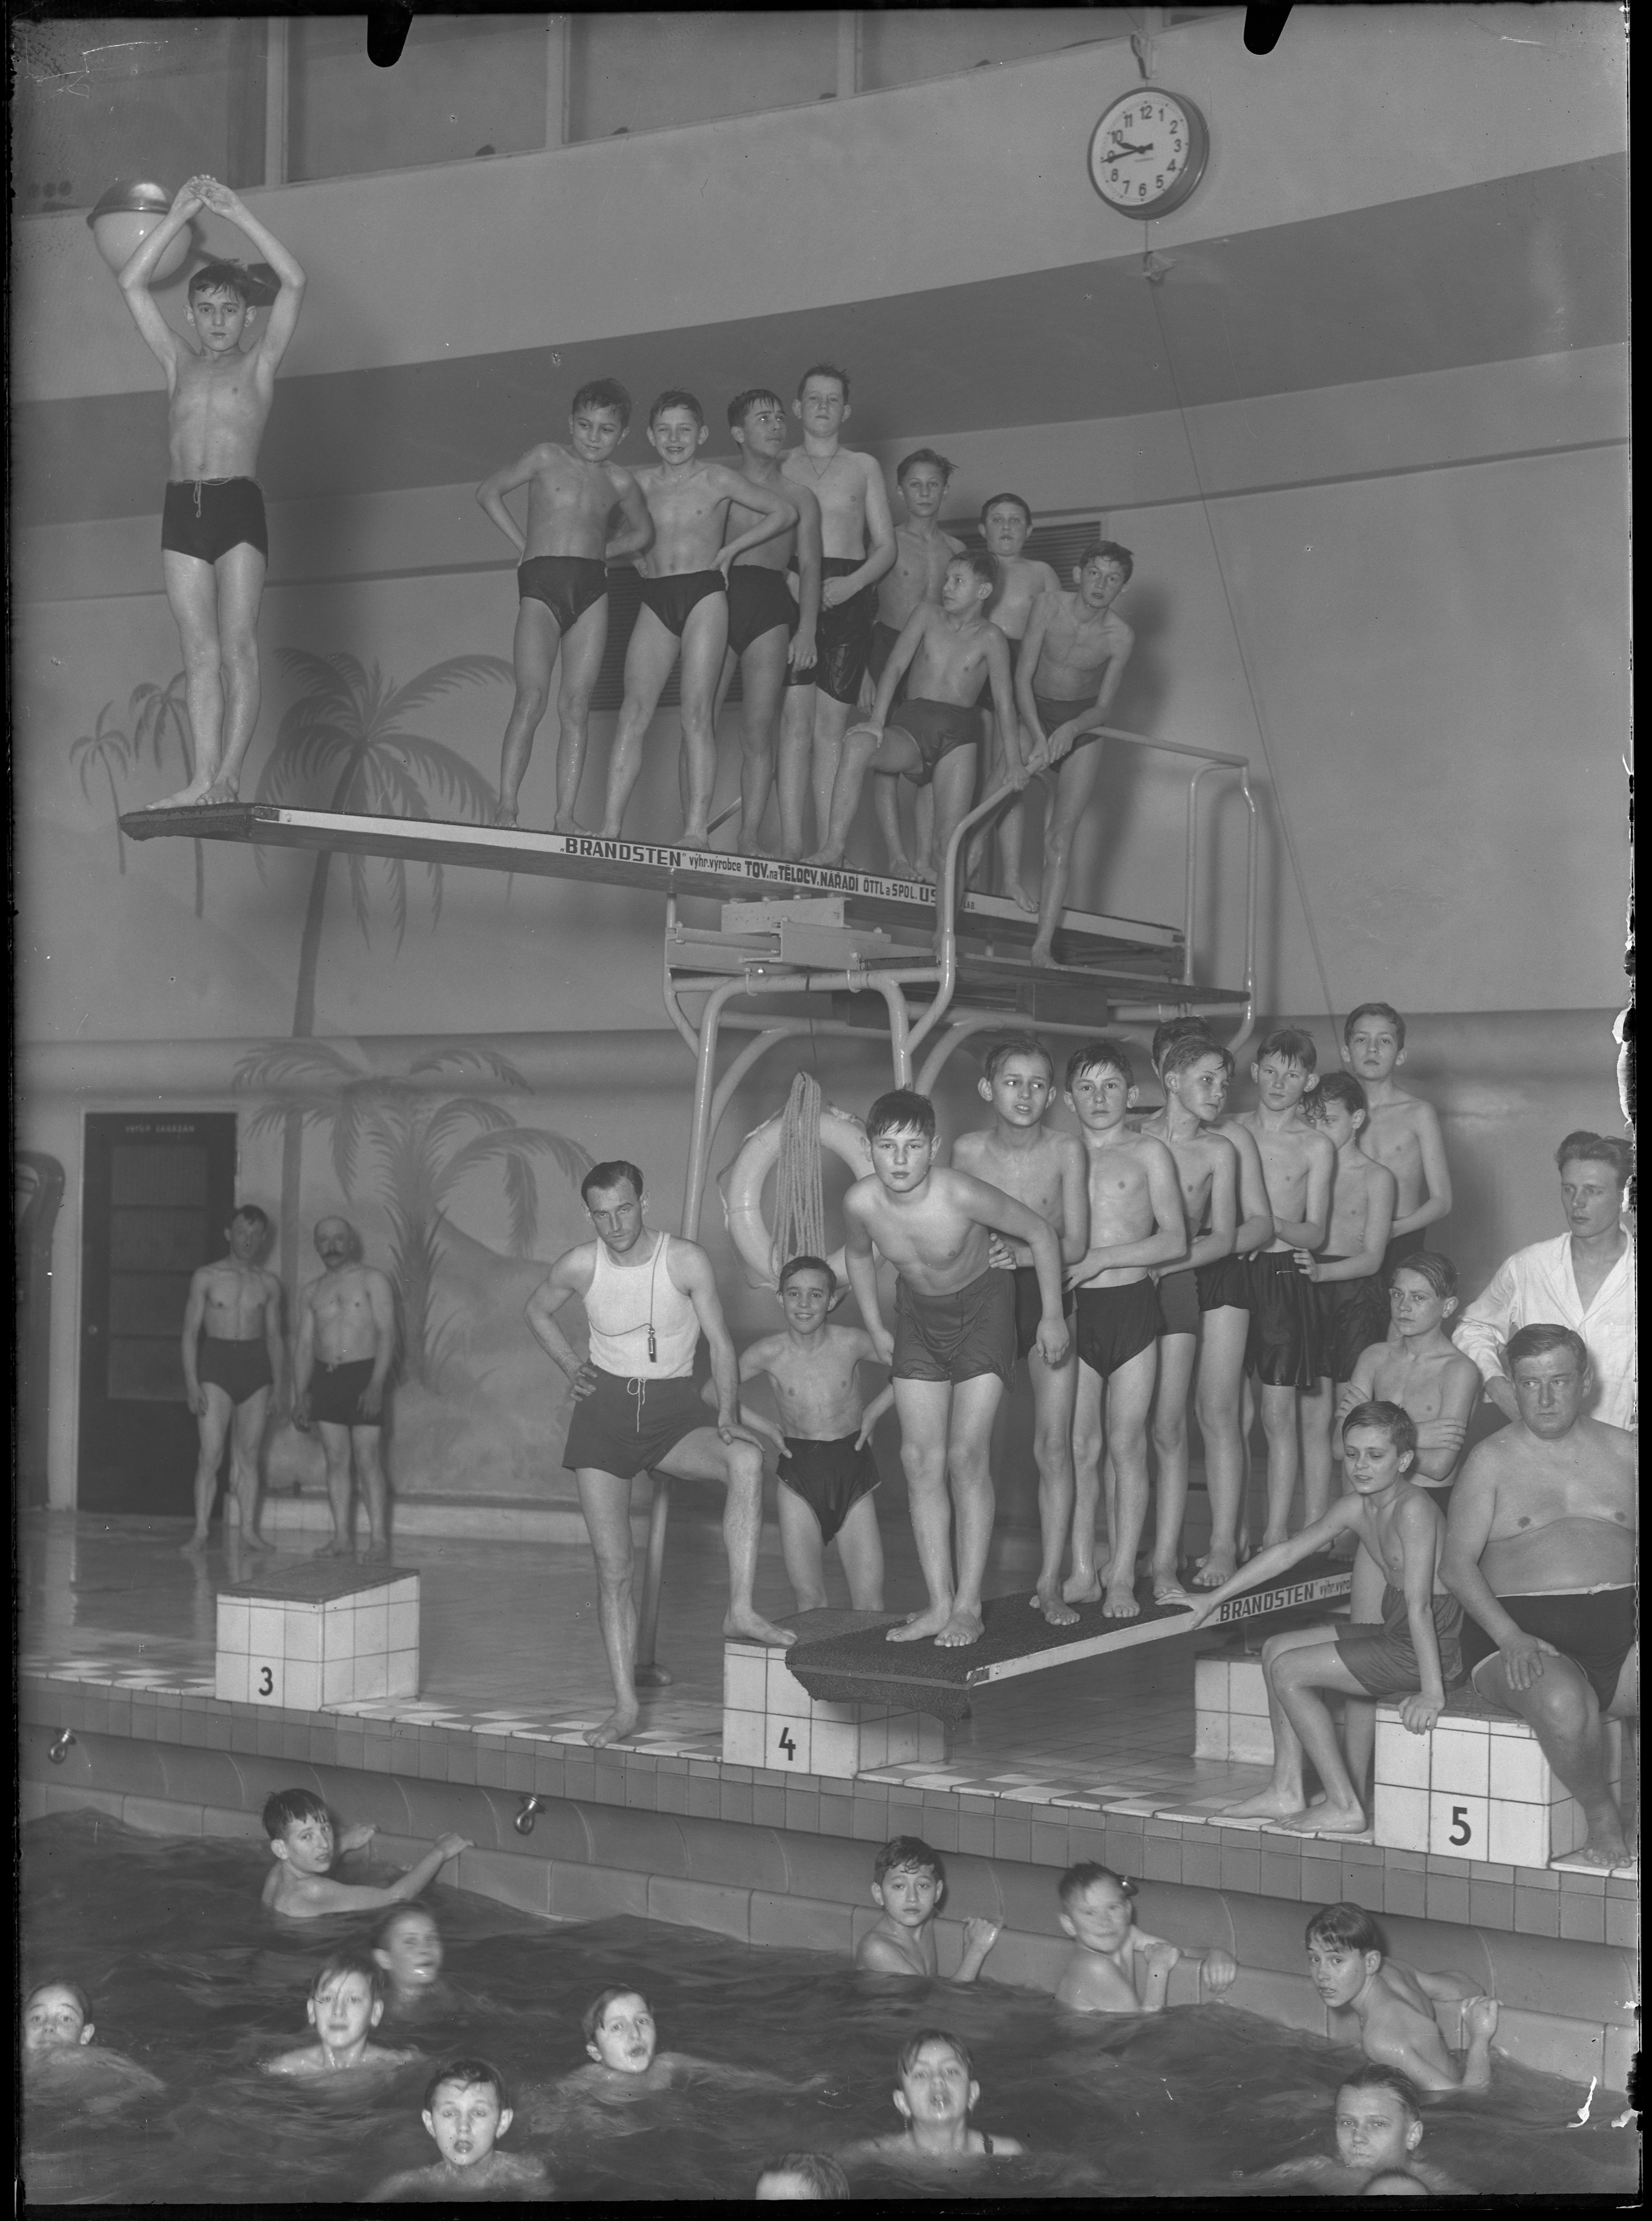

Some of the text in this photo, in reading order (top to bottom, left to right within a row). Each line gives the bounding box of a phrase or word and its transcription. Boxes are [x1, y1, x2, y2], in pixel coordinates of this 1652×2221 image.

[1140, 106, 1152, 119] 12
[1159, 108, 1163, 121] 1
[1124, 114, 1133, 128] 11
[1170, 120, 1178, 134] 2
[1111, 130, 1123, 144] 10
[1174, 139, 1181, 152] 3
[1167, 159, 1176, 172] 4
[1111, 169, 1118, 182] 8
[1156, 175, 1163, 188] 5
[1122, 180, 1130, 194] 7
[1139, 183, 1146, 196] 6
[820, 870, 858, 892] NÁŘADÍ
[863, 877, 884, 895] ÖTTL
[885, 887, 891, 896] a
[892, 883, 918, 900] SPOL.
[259, 1666, 273, 1696] 3
[779, 1727, 796, 1761] 4
[1448, 1806, 1472, 1846] 5
